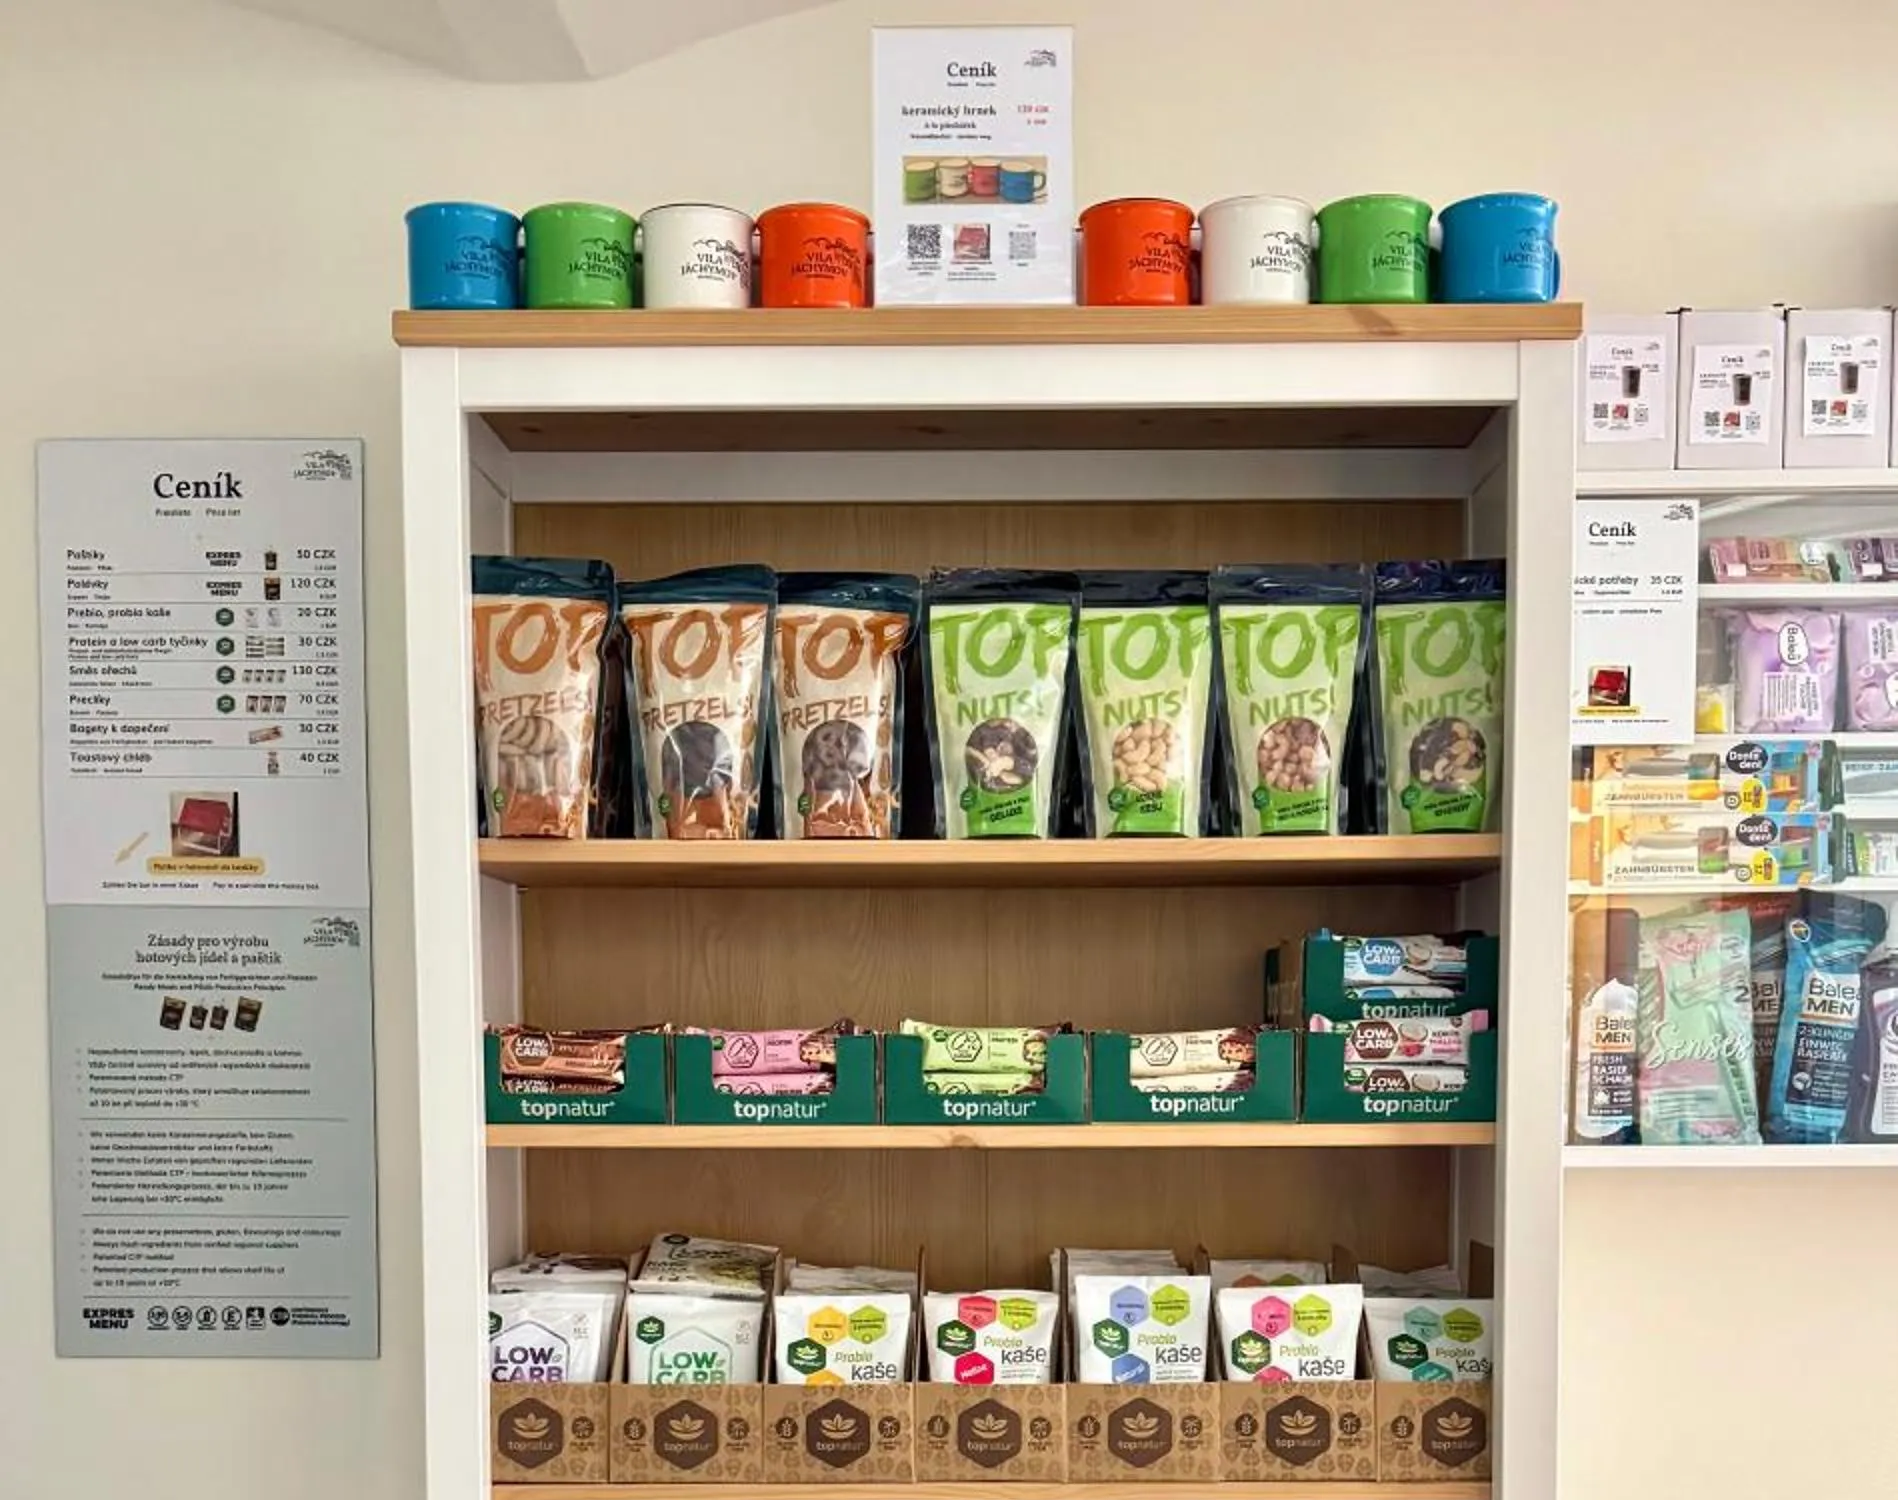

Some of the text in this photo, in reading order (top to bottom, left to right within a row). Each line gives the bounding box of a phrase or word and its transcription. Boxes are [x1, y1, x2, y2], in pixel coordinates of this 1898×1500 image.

[947, 62, 997, 77] Ceník
[902, 105, 997, 118] keramický hrnek
[697, 254, 723, 265] VILA
[807, 252, 833, 264] VILA
[154, 472, 243, 499] Ceník
[1588, 522, 1637, 537] Ceník
[314, 550, 336, 559] CZK
[314, 578, 337, 588] CZK
[1664, 576, 1683, 585] CZK
[314, 608, 337, 617] CZK
[120, 637, 139, 646] low
[142, 637, 167, 646] carb
[315, 636, 337, 646] CZK
[474, 602, 608, 692] TOP
[1378, 603, 1505, 695] TOP
[627, 603, 767, 698] TOP
[776, 613, 909, 699] TOP
[931, 606, 1071, 695] TOP
[1080, 607, 1209, 697] TOP
[1222, 606, 1359, 696] TOP
[316, 666, 337, 675] CZK
[316, 694, 338, 704] CZK
[1250, 686, 1337, 726] NUTS!
[1403, 682, 1493, 726] NUTS!
[316, 723, 338, 733] CZK
[300, 752, 314, 762] 40
[317, 752, 340, 762] CZK
[148, 934, 270, 950] Zásady pro výrobu
[1364, 944, 1396, 954] LOW
[136, 950, 282, 966] hotových jídel a paštik
[1363, 954, 1401, 964] CARB
[1362, 1002, 1456, 1019] topnatur
[1807, 998, 1855, 1016] MEN
[1595, 1015, 1632, 1030] Bale
[1356, 1028, 1389, 1039] LOW
[1595, 1032, 1631, 1042] MEN
[516, 1038, 545, 1048] LOW
[1355, 1039, 1394, 1050] CARB
[516, 1048, 549, 1057] CARB
[1370, 1078, 1401, 1088] LOW
[520, 1100, 615, 1120] topnatur
[734, 1100, 827, 1121] topnatur
[943, 1100, 1037, 1120] topnatur
[1150, 1095, 1244, 1118] topnatur
[1363, 1096, 1458, 1116] topnatur
[83, 1308, 135, 1319] EXPRES
[89, 1319, 129, 1330] MENU
[494, 1346, 554, 1364] LOW
[659, 1352, 718, 1368] LOW
[1000, 1346, 1047, 1364] kaše
[1155, 1344, 1202, 1364] kaše
[492, 1366, 563, 1382] CARB
[852, 1361, 898, 1381] kaše
[1300, 1356, 1346, 1376] kaše
[1456, 1358, 1491, 1374] kaš
[656, 1372, 726, 1384] CARB
